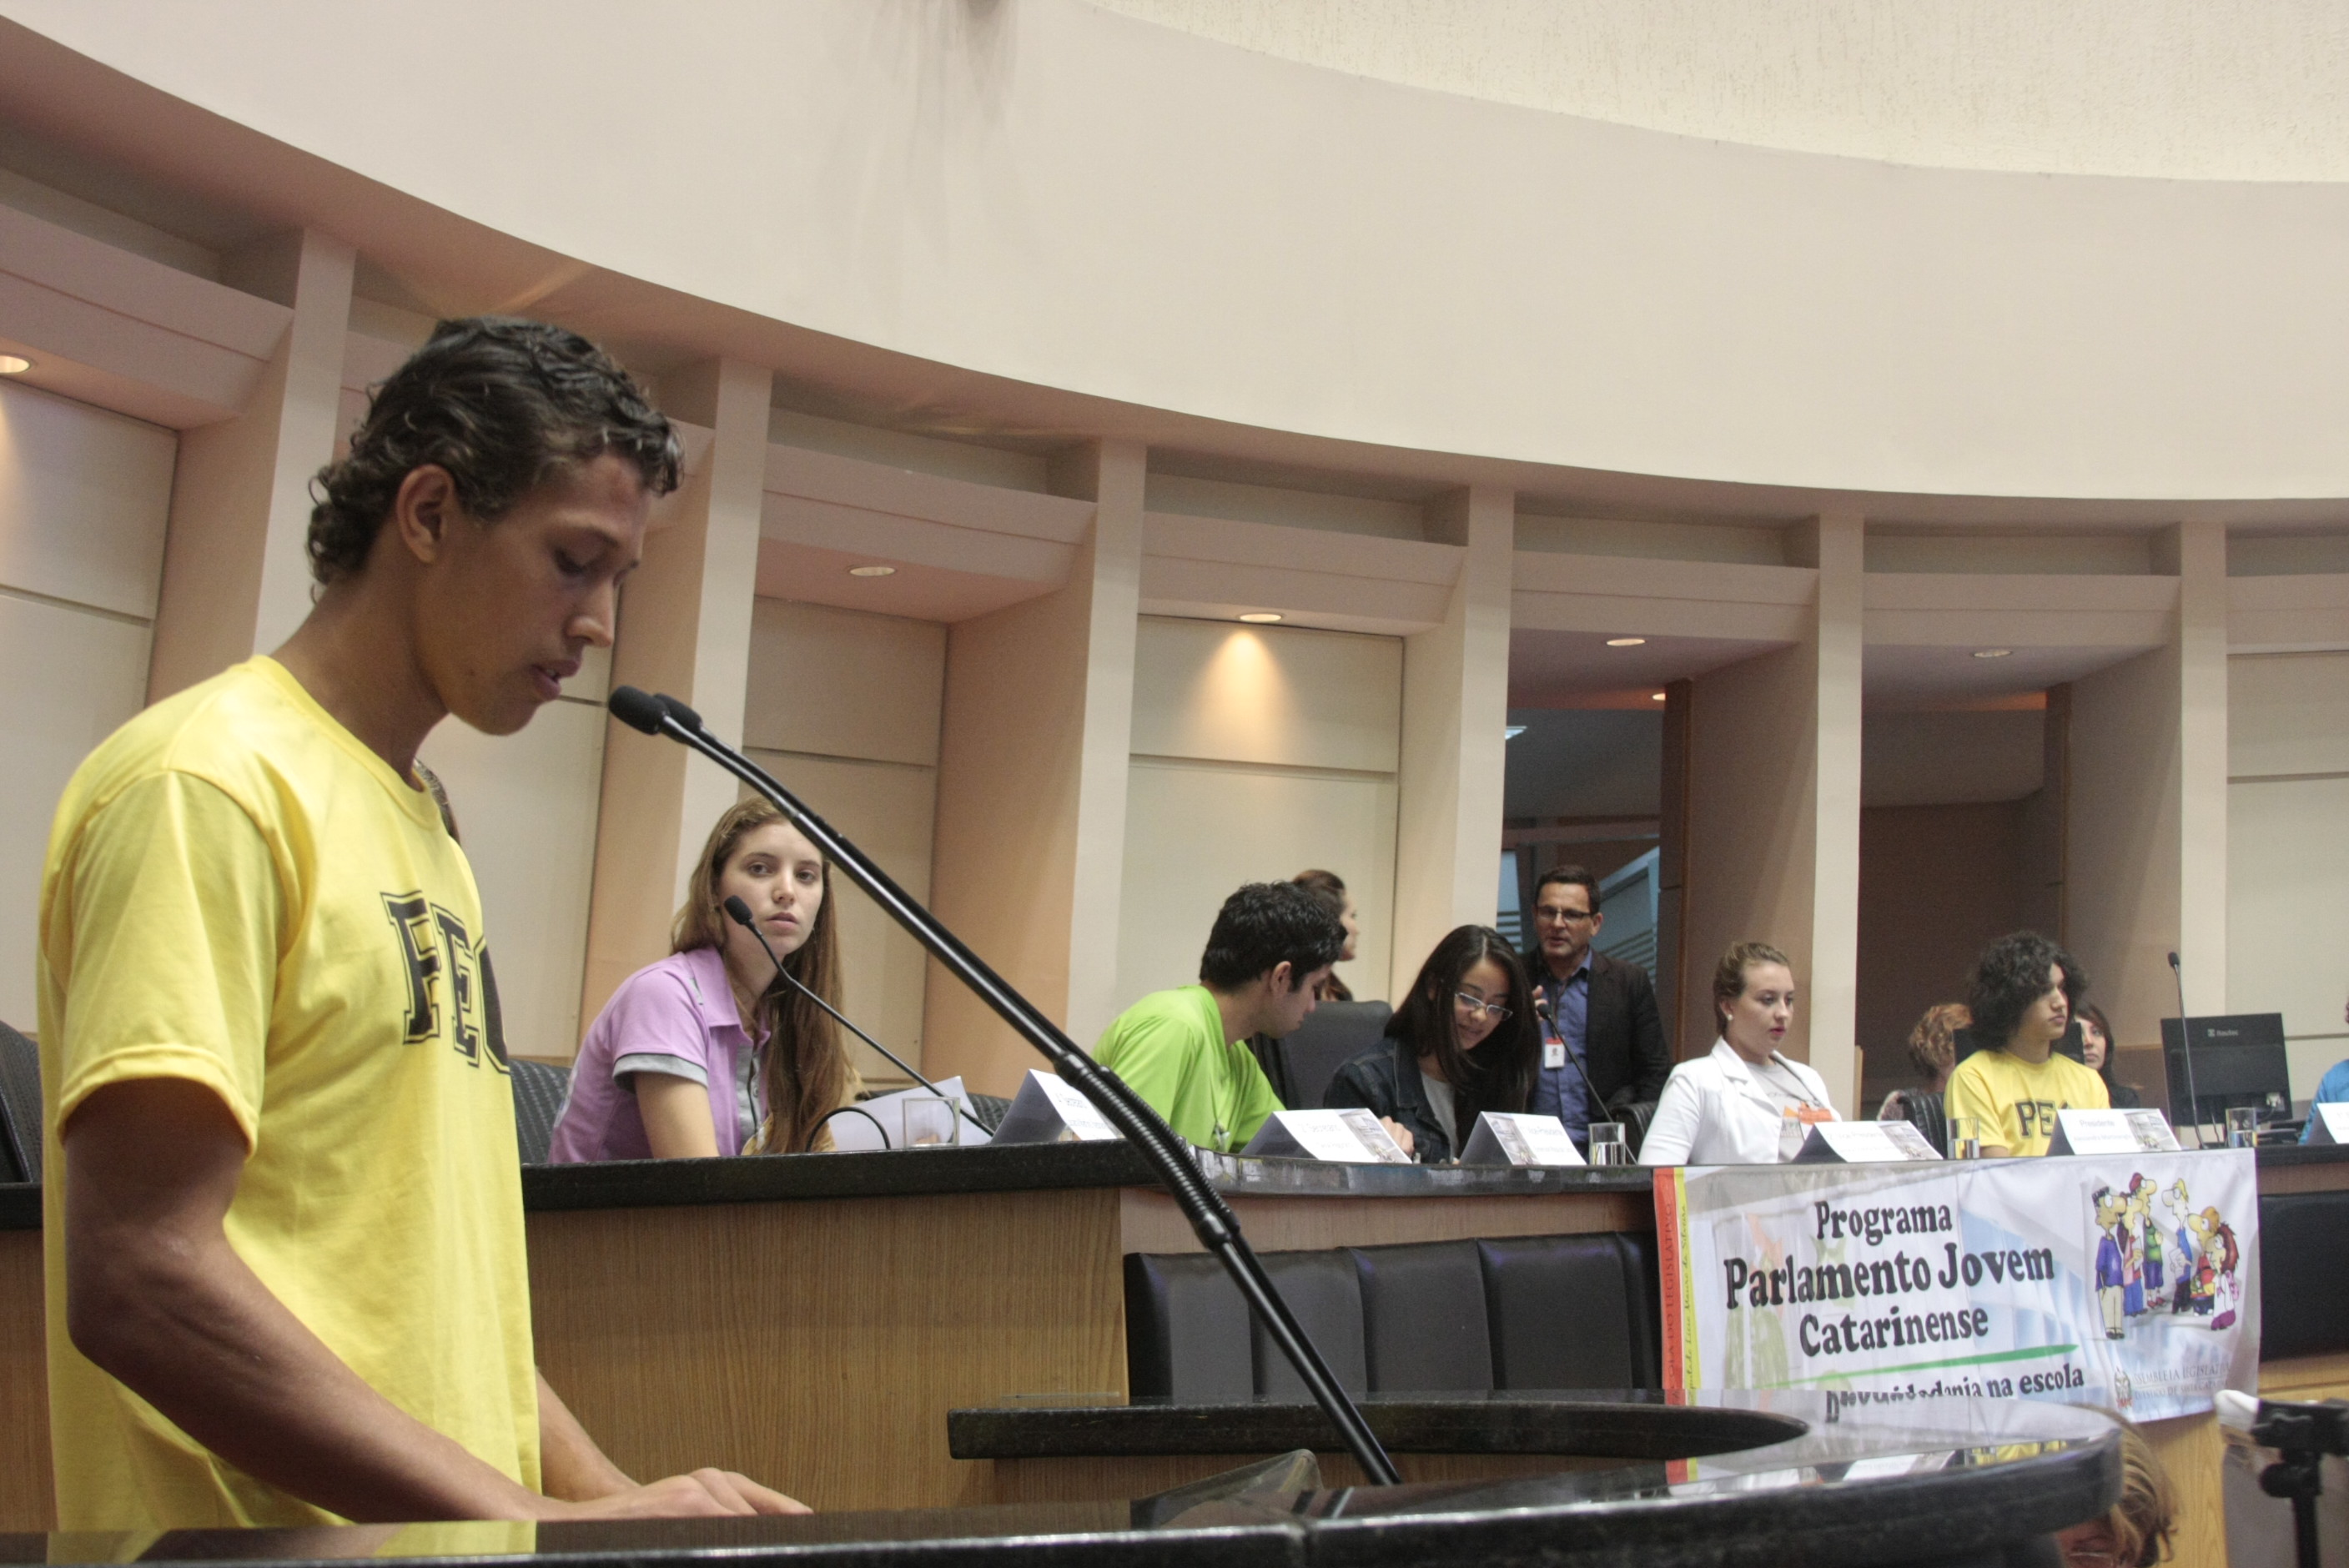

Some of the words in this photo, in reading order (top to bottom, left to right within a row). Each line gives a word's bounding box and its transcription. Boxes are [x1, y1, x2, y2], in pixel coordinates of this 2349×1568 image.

[2014, 1098, 2070, 1139] PE
[1813, 1200, 1953, 1246] Programa
[1664, 1203, 1674, 1307] LEGISLATIVO
[1723, 1250, 1931, 1309] Parlamento
[1938, 1242, 2055, 1289] Jovem
[1799, 1305, 1989, 1358] Catarinense
[1986, 1377, 2014, 1398] na
[2019, 1362, 2085, 1395] escola
